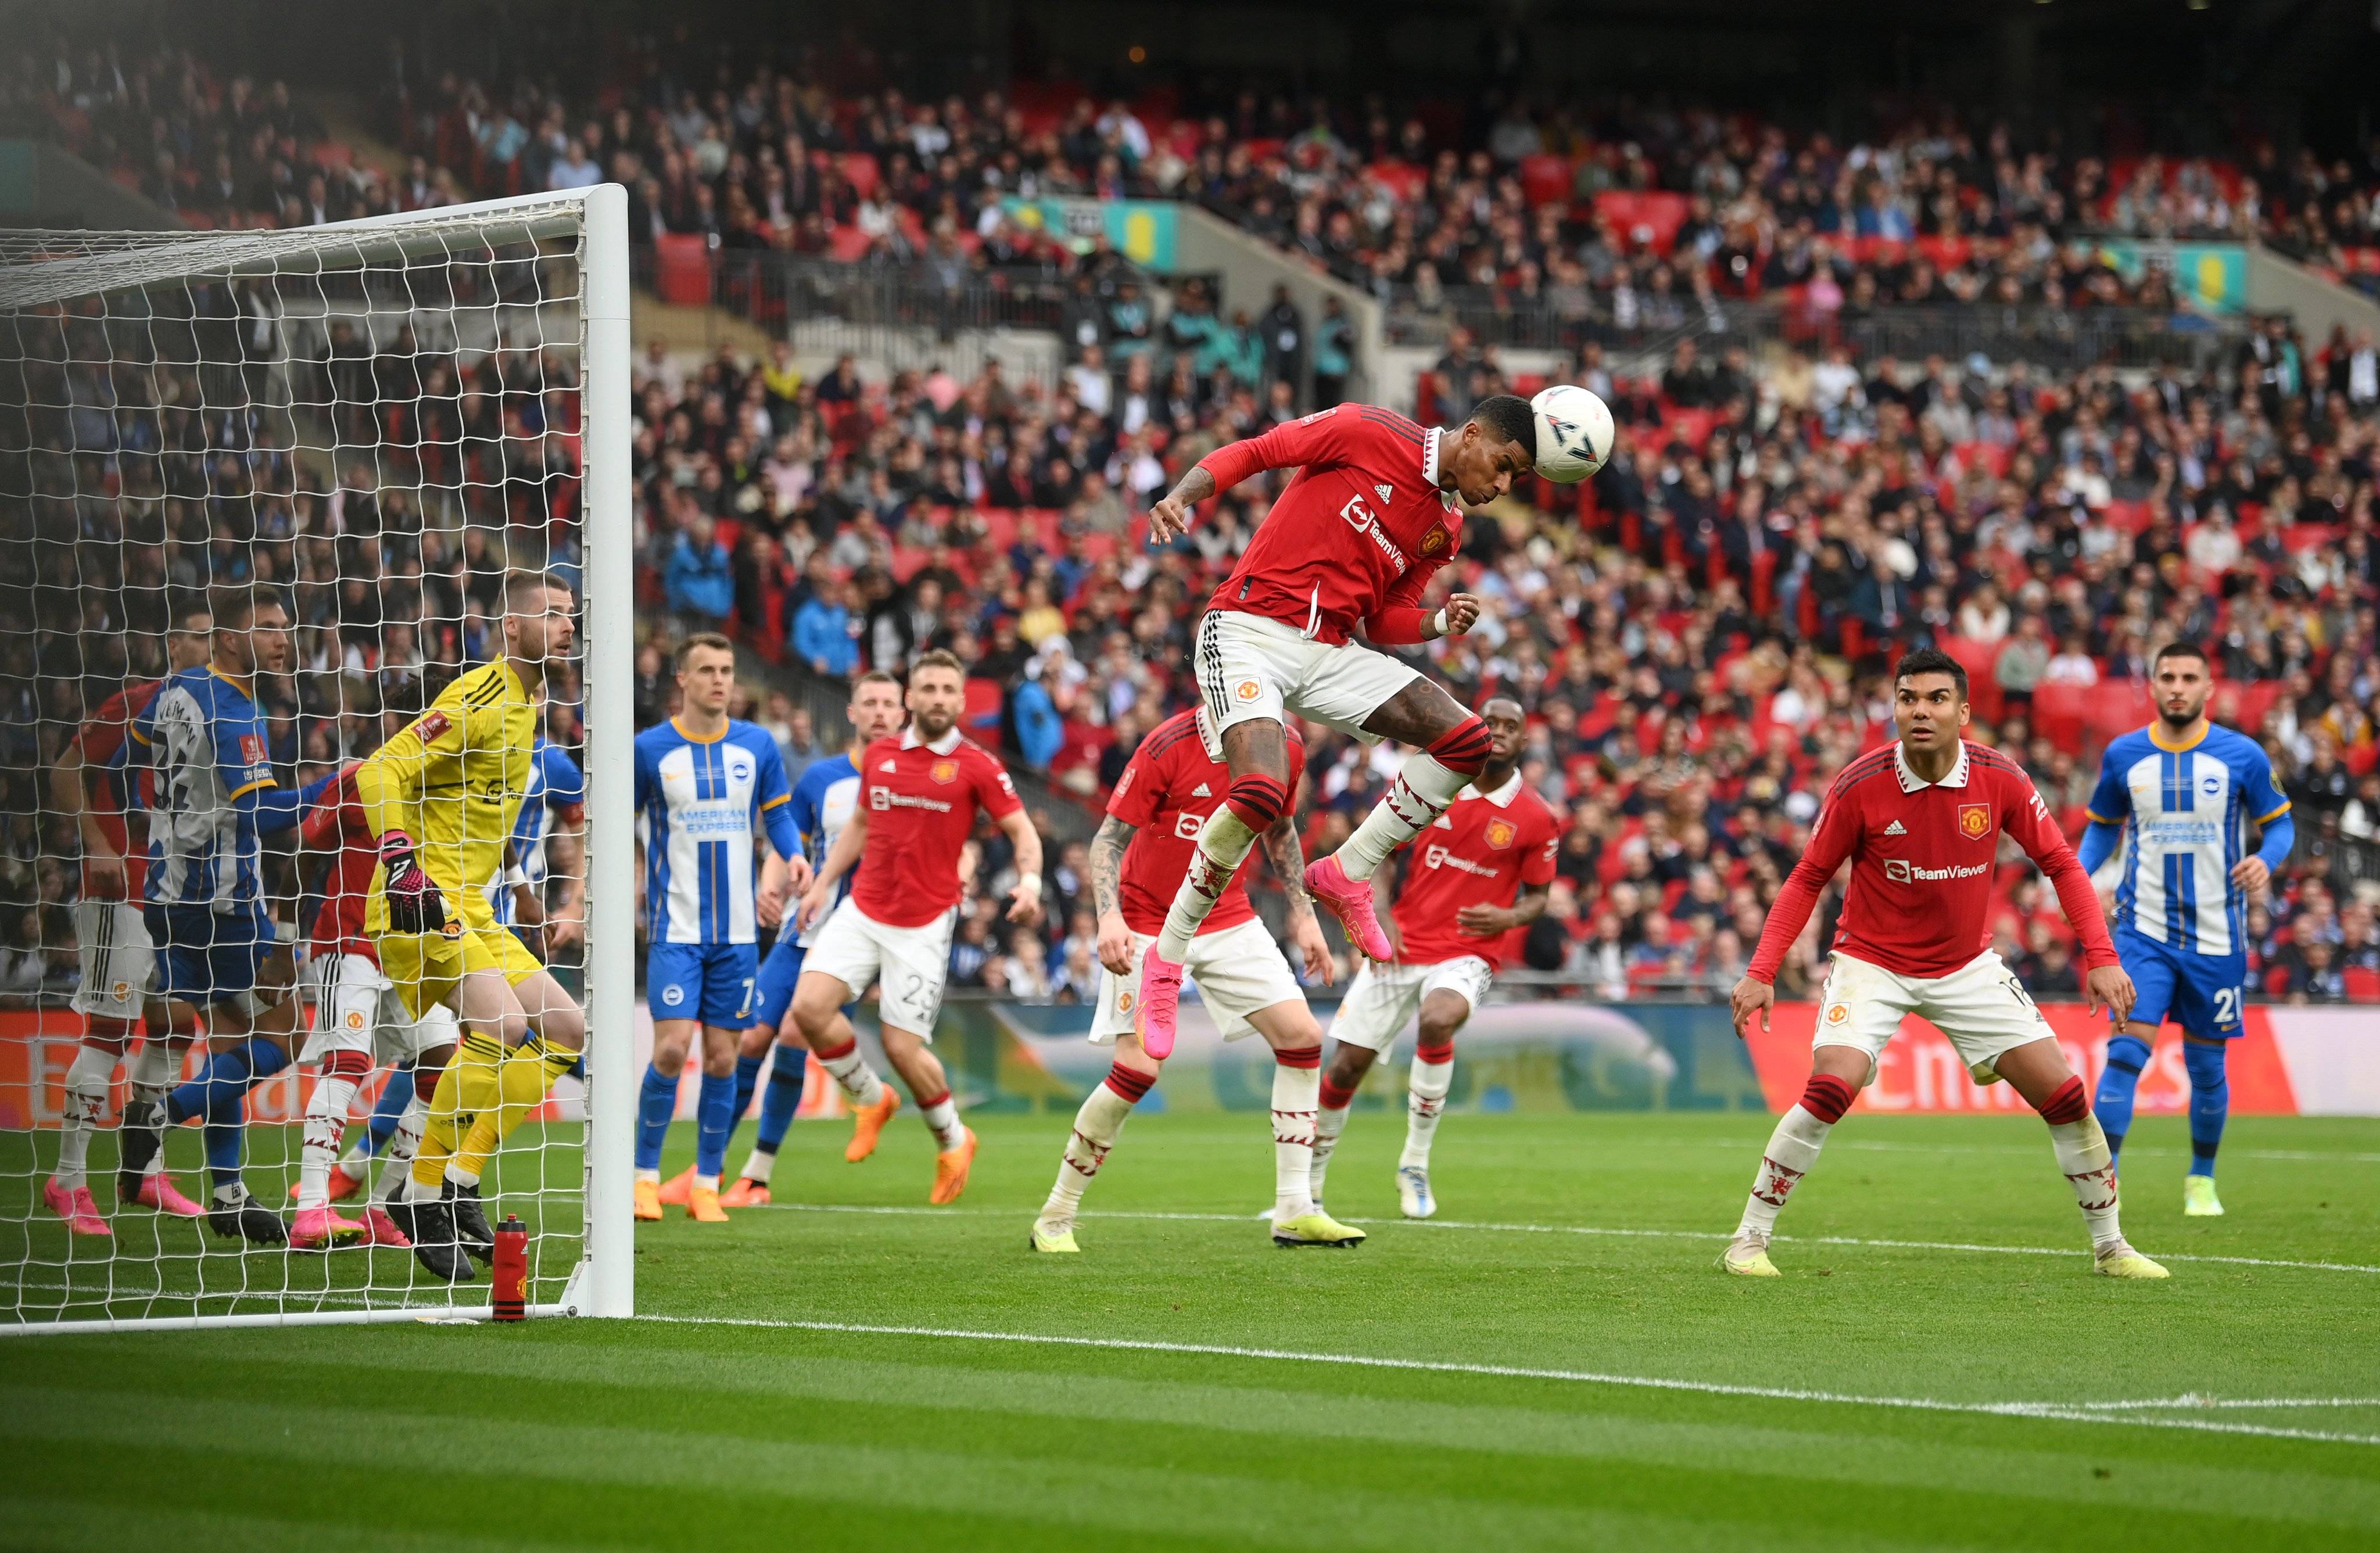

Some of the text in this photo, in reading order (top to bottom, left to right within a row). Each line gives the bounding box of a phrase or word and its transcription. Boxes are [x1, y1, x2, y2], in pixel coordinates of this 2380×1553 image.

[1374, 485, 1390, 505] adidas
[1369, 519, 1406, 576] TeamView
[687, 822, 747, 834] EXPRESS
[1911, 862, 1989, 880] TeamViewer
[741, 977, 755, 1013] 7
[2213, 985, 2243, 1023] 21
